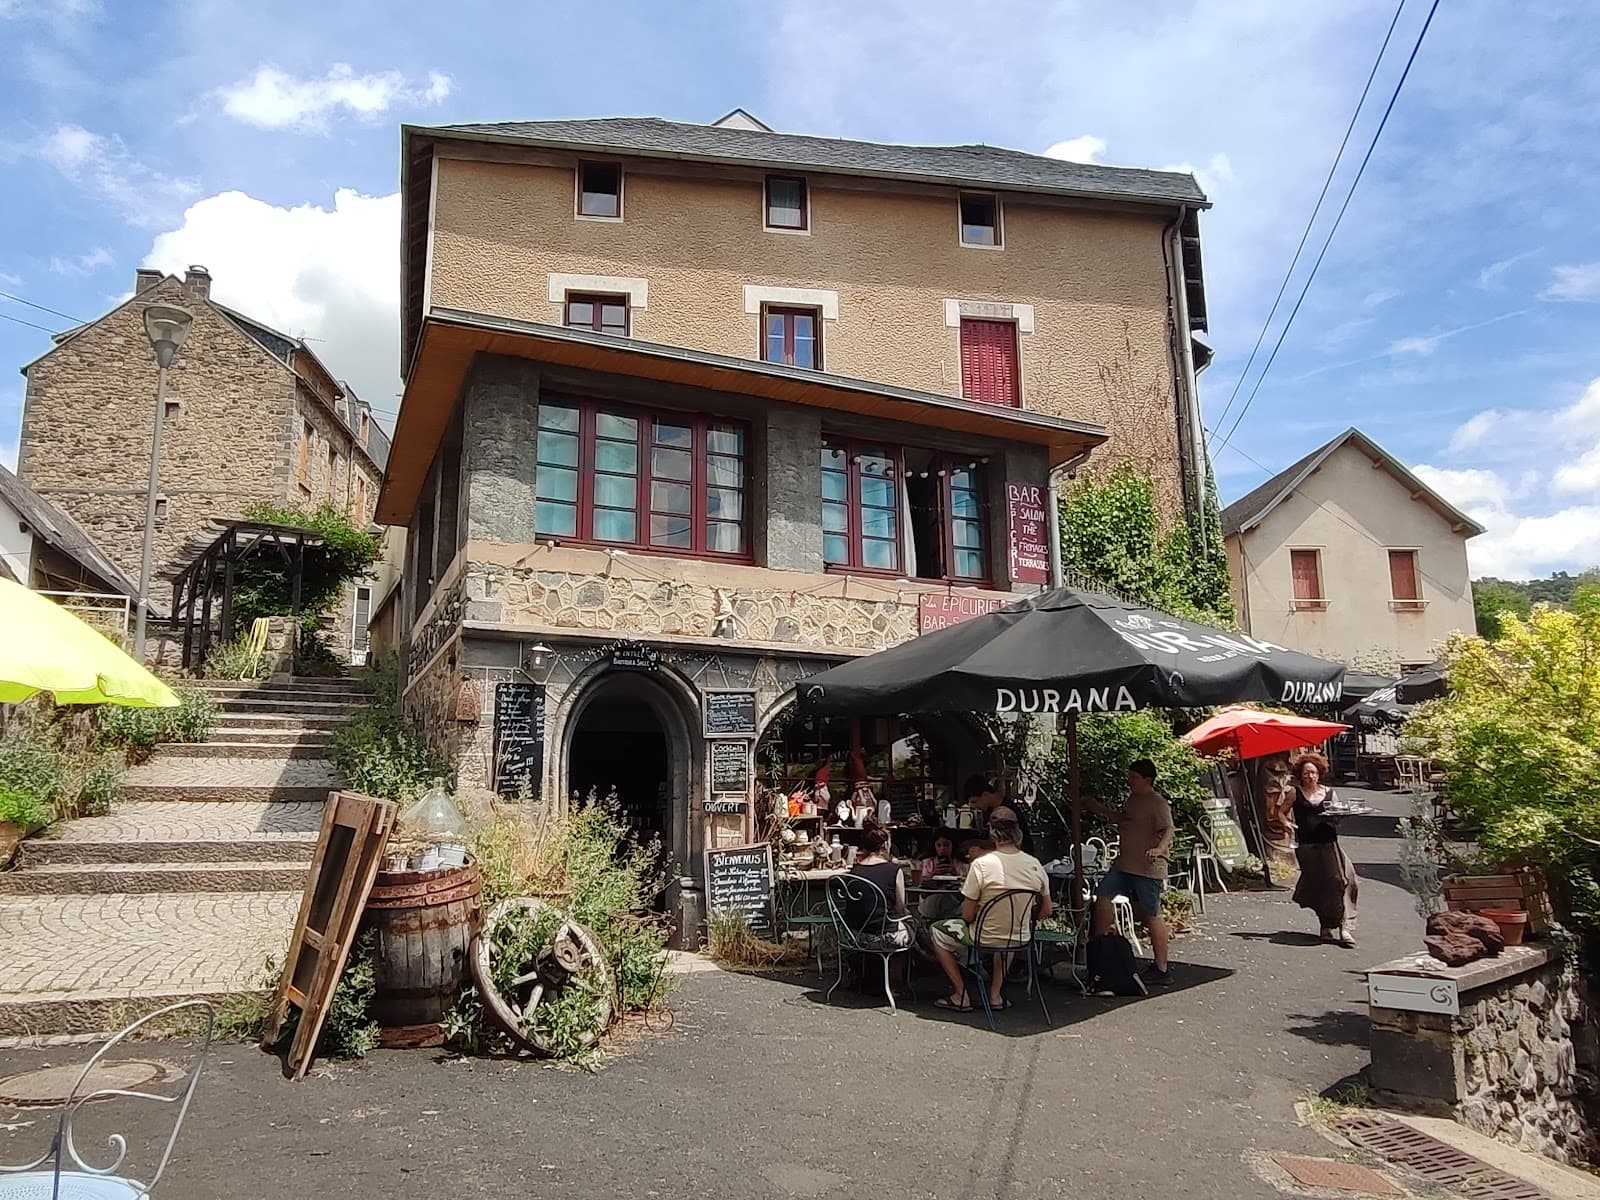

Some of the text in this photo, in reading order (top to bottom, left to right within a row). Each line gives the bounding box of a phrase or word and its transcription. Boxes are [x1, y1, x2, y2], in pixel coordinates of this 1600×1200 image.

[1009, 485, 1041, 504] BAR
[1019, 508, 1045, 522] SALON
[1010, 501, 1018, 578] EPICERIE
[1018, 542, 1049, 555] FROMAGES
[1018, 558, 1050, 571] TERRASSES
[942, 596, 1013, 616] EPICURIE
[996, 685, 1137, 713] DURANA
[1281, 680, 1342, 704] DURANA
[704, 802, 740, 813] OUVERT
[714, 852, 761, 867] BIENVENUS
